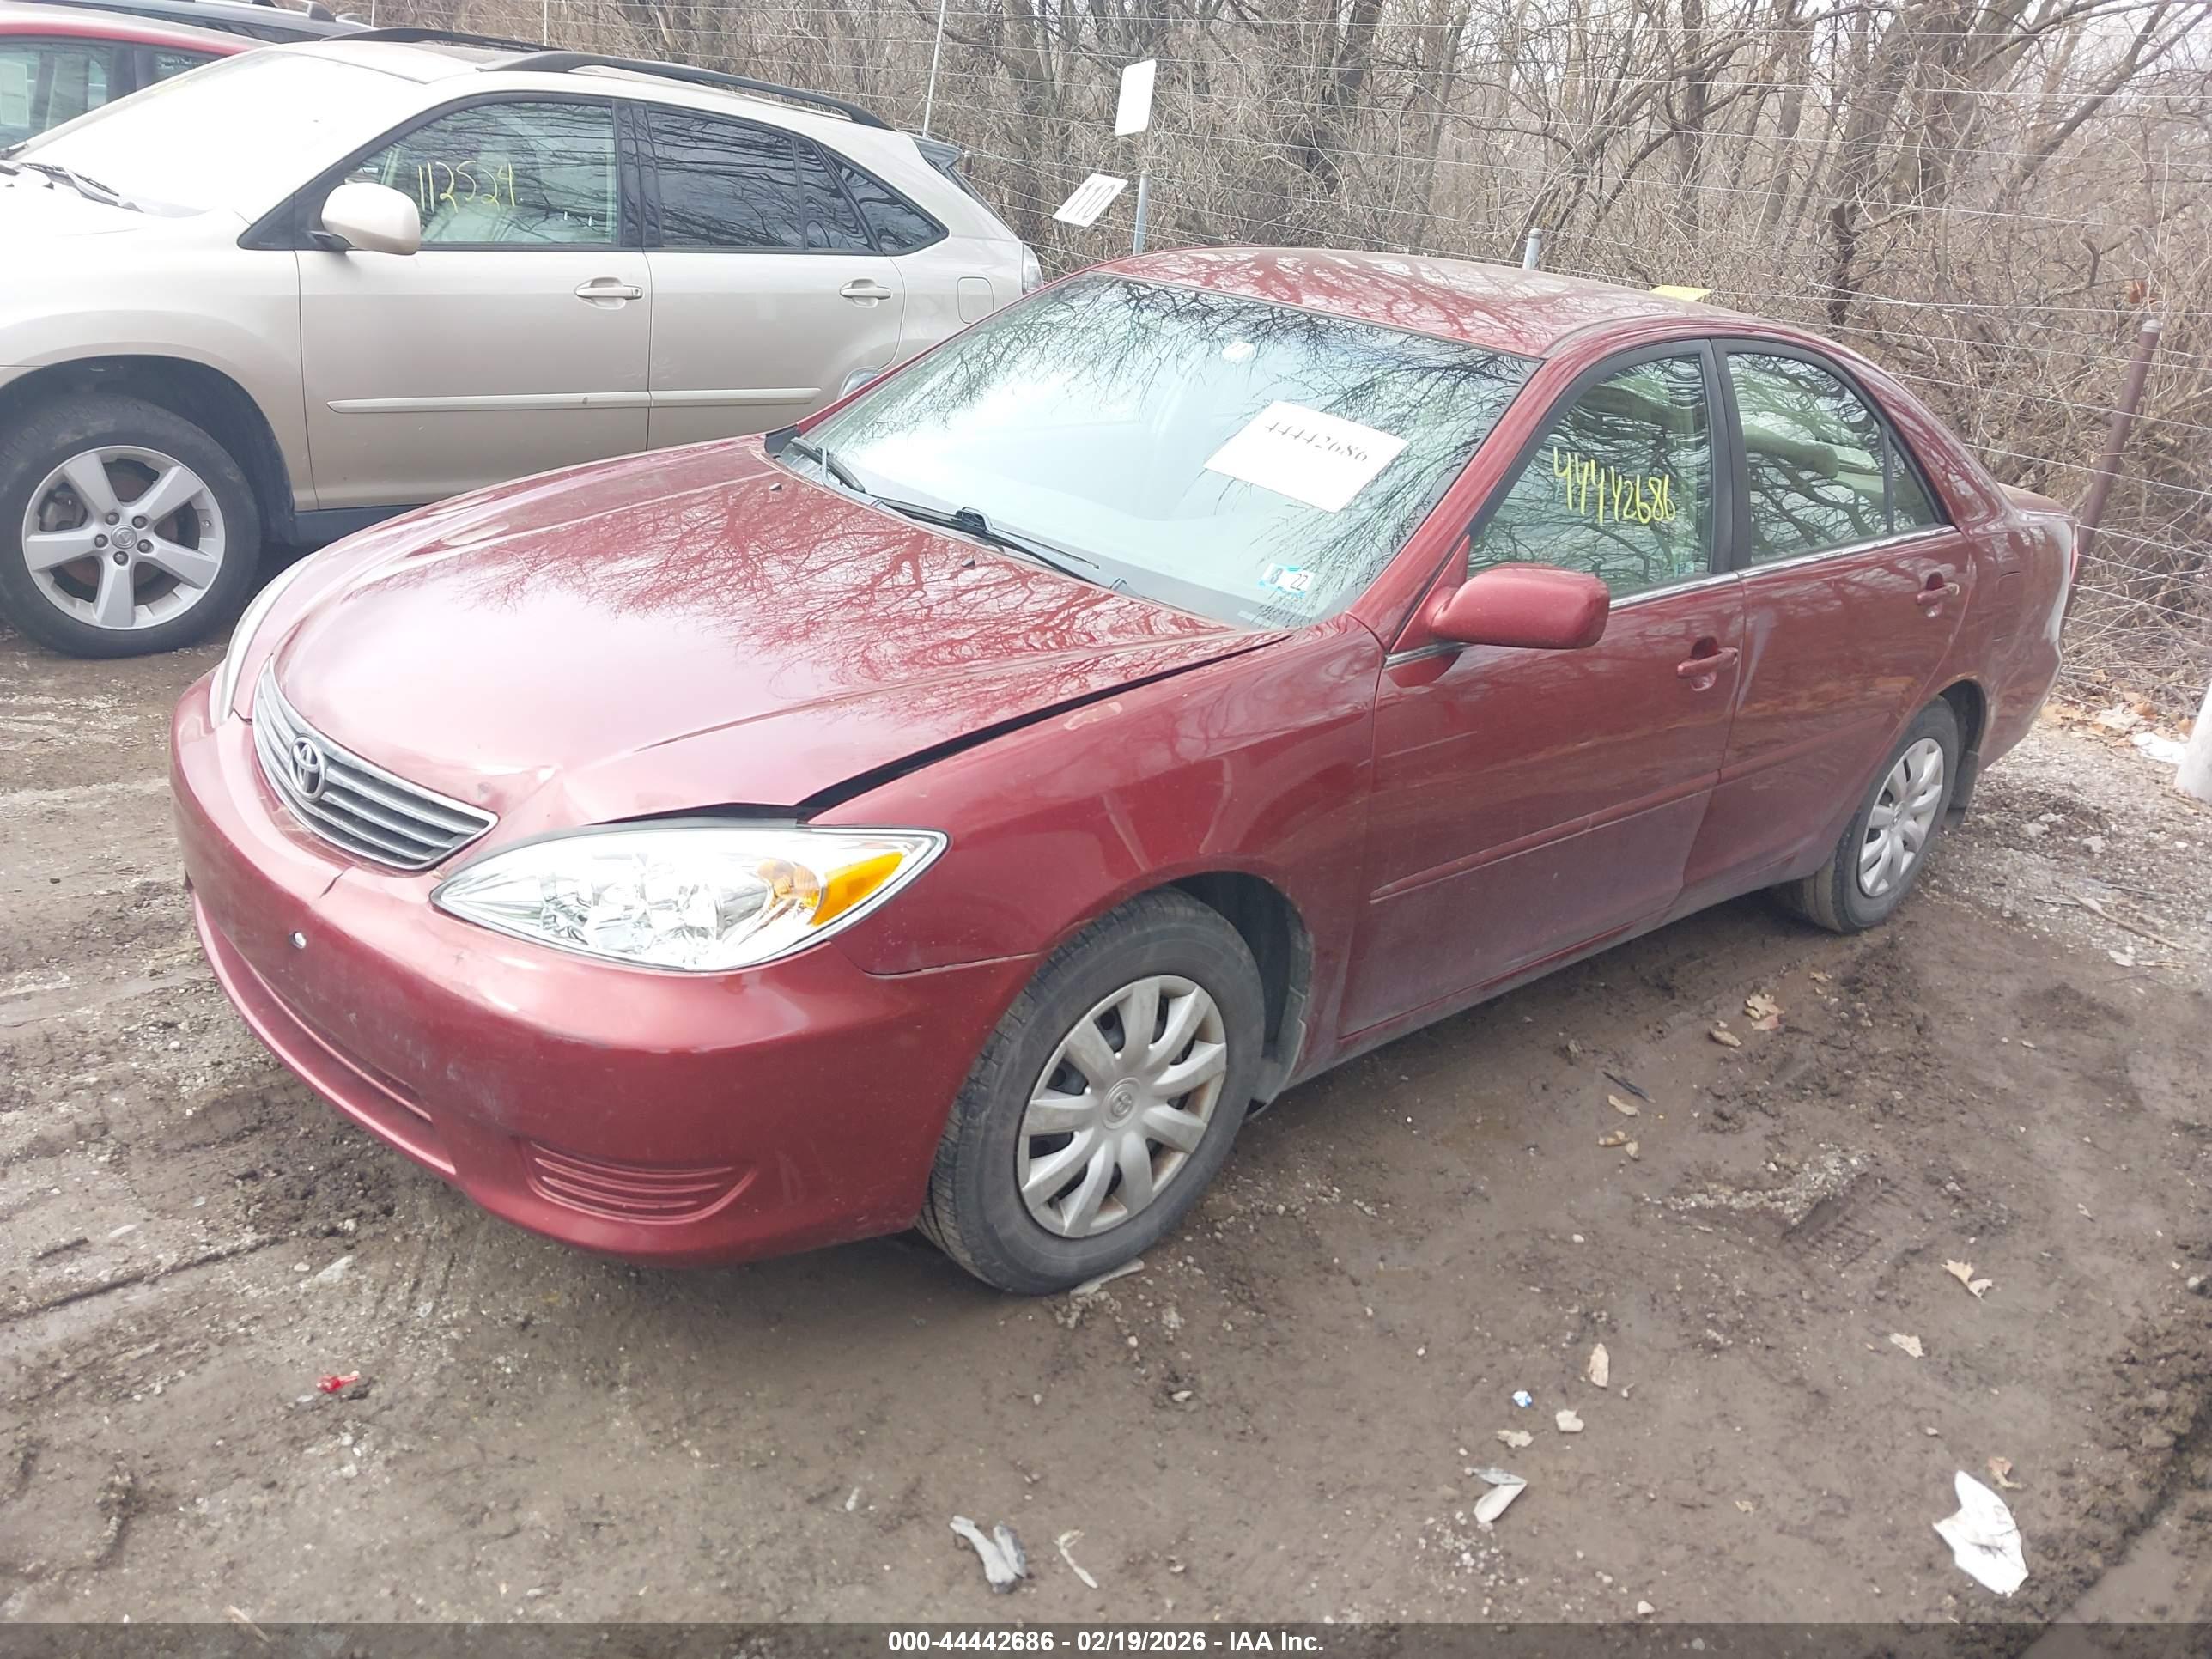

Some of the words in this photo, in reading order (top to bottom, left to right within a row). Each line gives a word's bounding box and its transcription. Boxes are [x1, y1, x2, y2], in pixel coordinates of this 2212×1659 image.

[418, 160, 515, 213] 112524
[1065, 181, 1115, 220] 110
[1265, 421, 1368, 462] 44442686
[1553, 446, 1676, 525] 44442686
